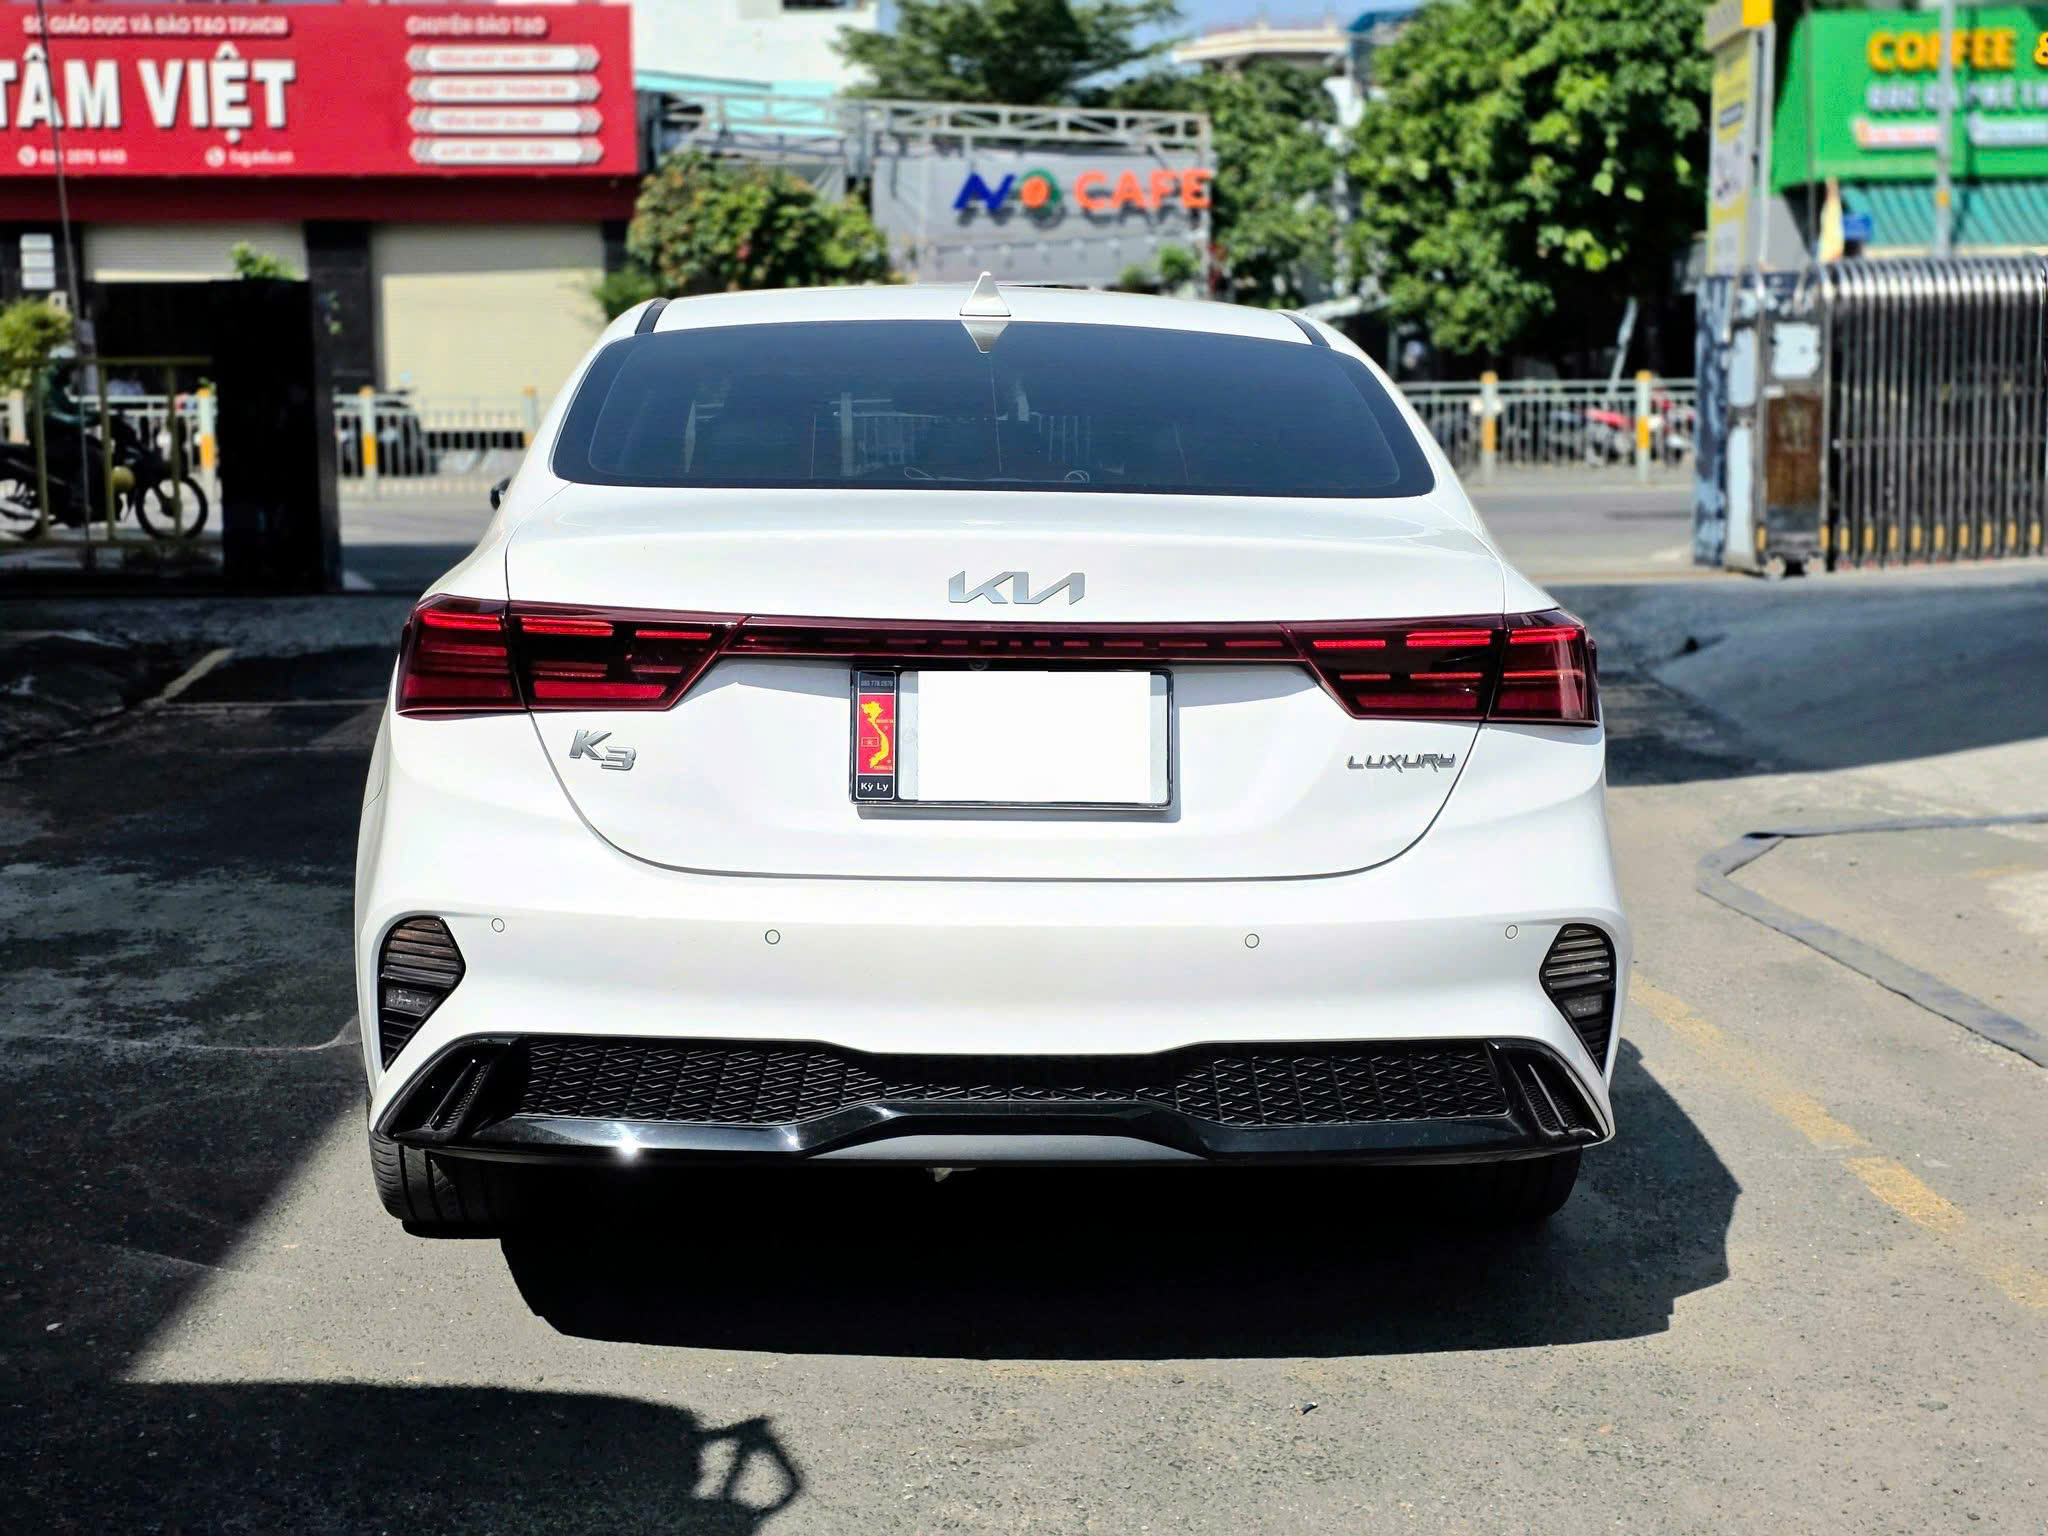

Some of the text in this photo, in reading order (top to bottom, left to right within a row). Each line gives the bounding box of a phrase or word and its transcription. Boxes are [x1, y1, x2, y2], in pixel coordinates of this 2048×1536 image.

[1869, 30, 2015, 69] COFFEE
[0, 40, 296, 144] TÂM VIỆT
[1073, 169, 1211, 212] CAFE
[948, 570, 1086, 606] KIA
[568, 729, 637, 771] K3
[1346, 753, 1457, 774] LUXURY
[876, 782, 889, 792] Ly
